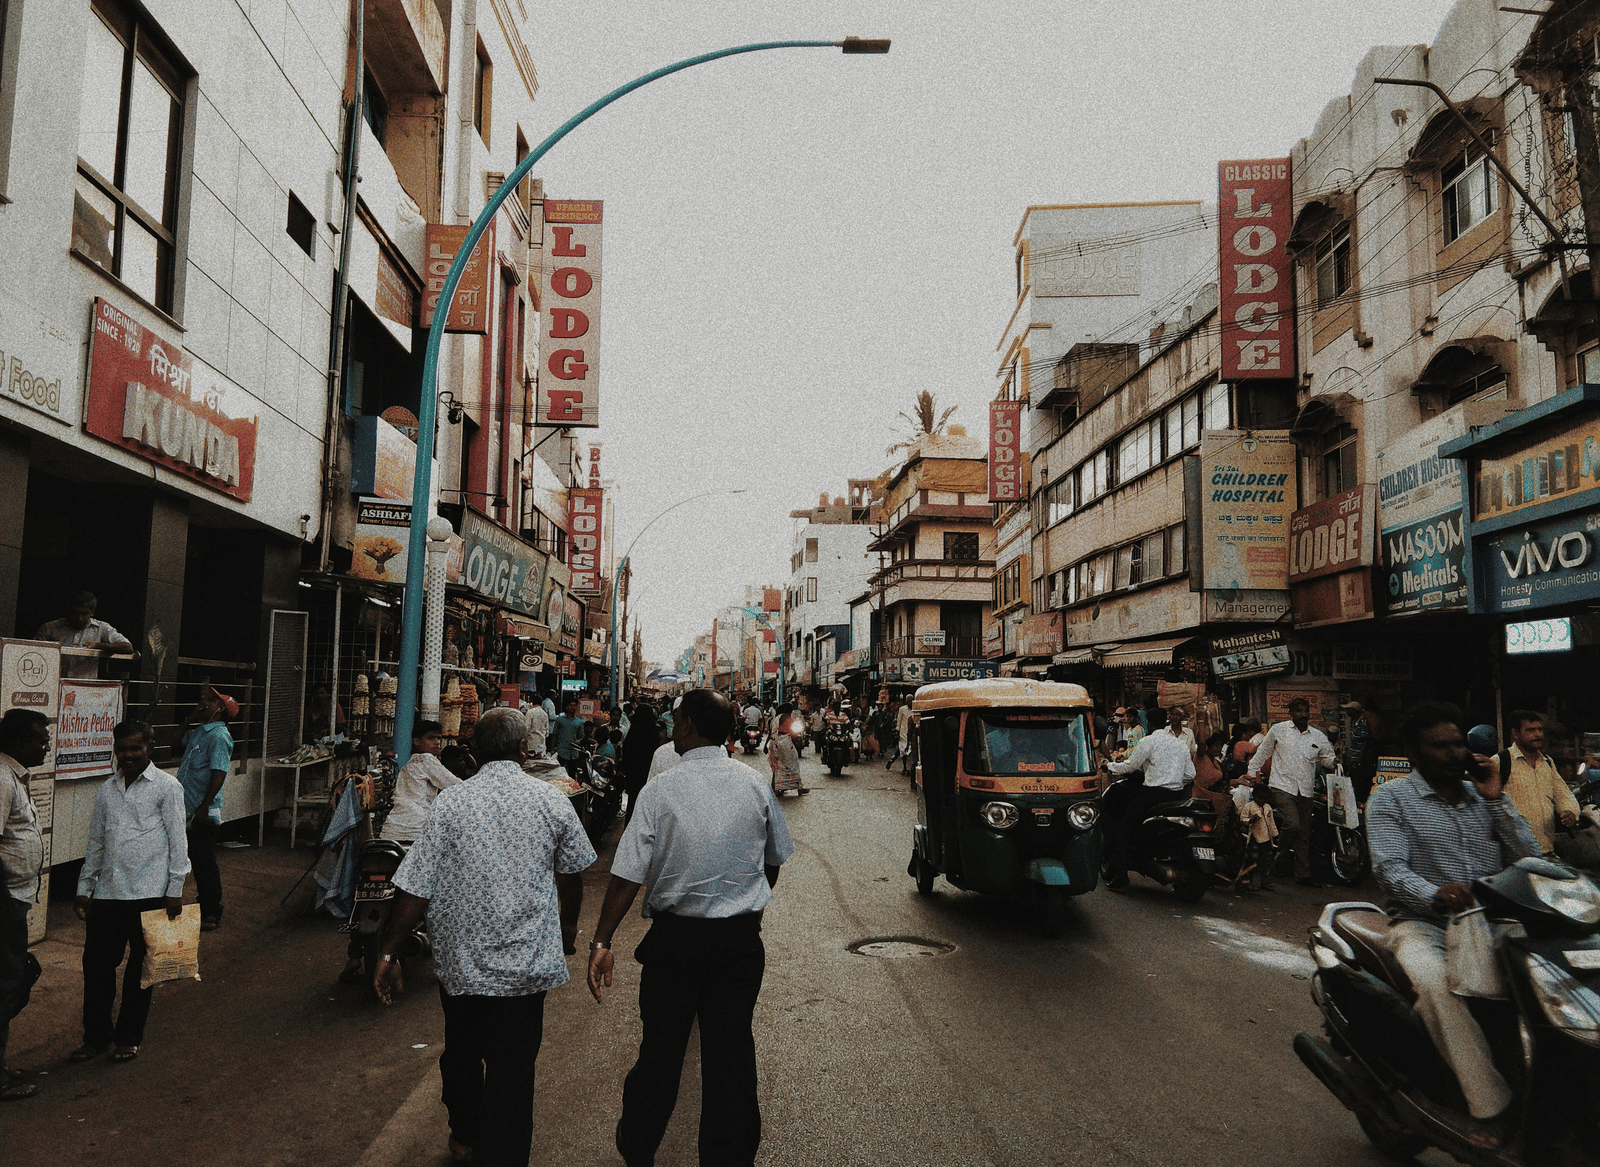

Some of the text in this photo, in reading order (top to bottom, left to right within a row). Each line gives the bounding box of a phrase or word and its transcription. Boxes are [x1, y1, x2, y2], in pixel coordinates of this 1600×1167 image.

[1225, 164, 1286, 181] CLASSIC
[1233, 188, 1281, 370] LODGE
[97, 317, 118, 341] SINCE
[103, 304, 139, 335] ORIGINAL
[547, 226, 592, 421] LODGE
[9, 355, 61, 413] Food
[122, 380, 240, 487] KUNDA
[994, 411, 1015, 497] LODGE
[1211, 473, 1288, 486] CHILDREN
[1211, 489, 1284, 502] HOSPITAL
[1379, 463, 1419, 502] CHILDREN
[571, 496, 597, 589] LODGE
[1290, 512, 1360, 576] LODGE
[1389, 513, 1465, 567] MASOOM
[1500, 531, 1587, 579] vivo
[458, 545, 520, 604] ODGE
[1402, 558, 1459, 594] Medicals
[1501, 583, 1532, 596] Honesty
[1212, 630, 1281, 650] Mahantesh
[22, 659, 44, 674] Pai
[929, 668, 994, 678] MEDICAS
[59, 712, 115, 733] Mishra Pedha
[1380, 760, 1411, 768] HONESTY
